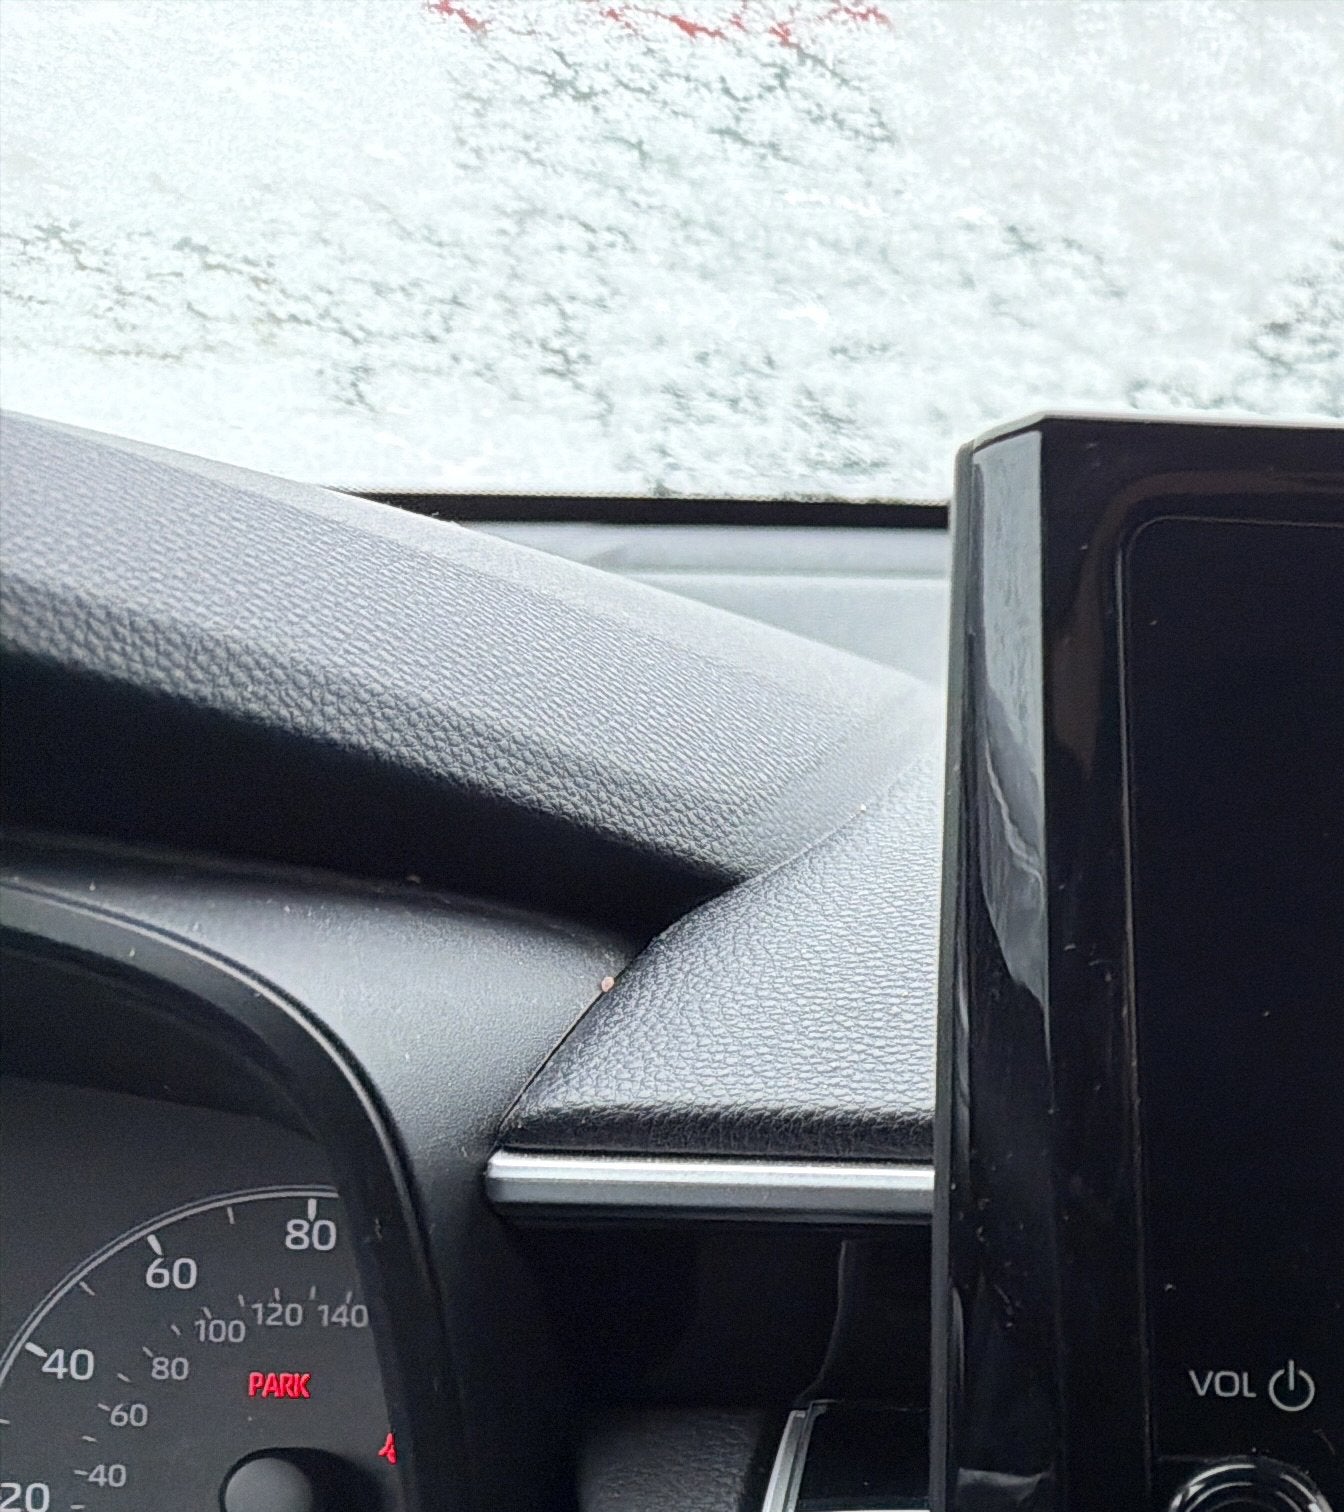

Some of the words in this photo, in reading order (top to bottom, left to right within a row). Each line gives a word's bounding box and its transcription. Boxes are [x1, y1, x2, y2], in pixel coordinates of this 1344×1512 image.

[286, 1219, 336, 1250] 80
[146, 1258, 197, 1289] 60
[252, 1303, 302, 1326] 120
[318, 1305, 368, 1327] 140
[195, 1320, 245, 1342] 100
[41, 1348, 94, 1380] 40
[152, 1357, 188, 1380] 80
[249, 1372, 310, 1397] PARK
[1189, 1371, 1256, 1397] VOL
[111, 1404, 147, 1426] 60
[88, 1464, 126, 1487] 40
